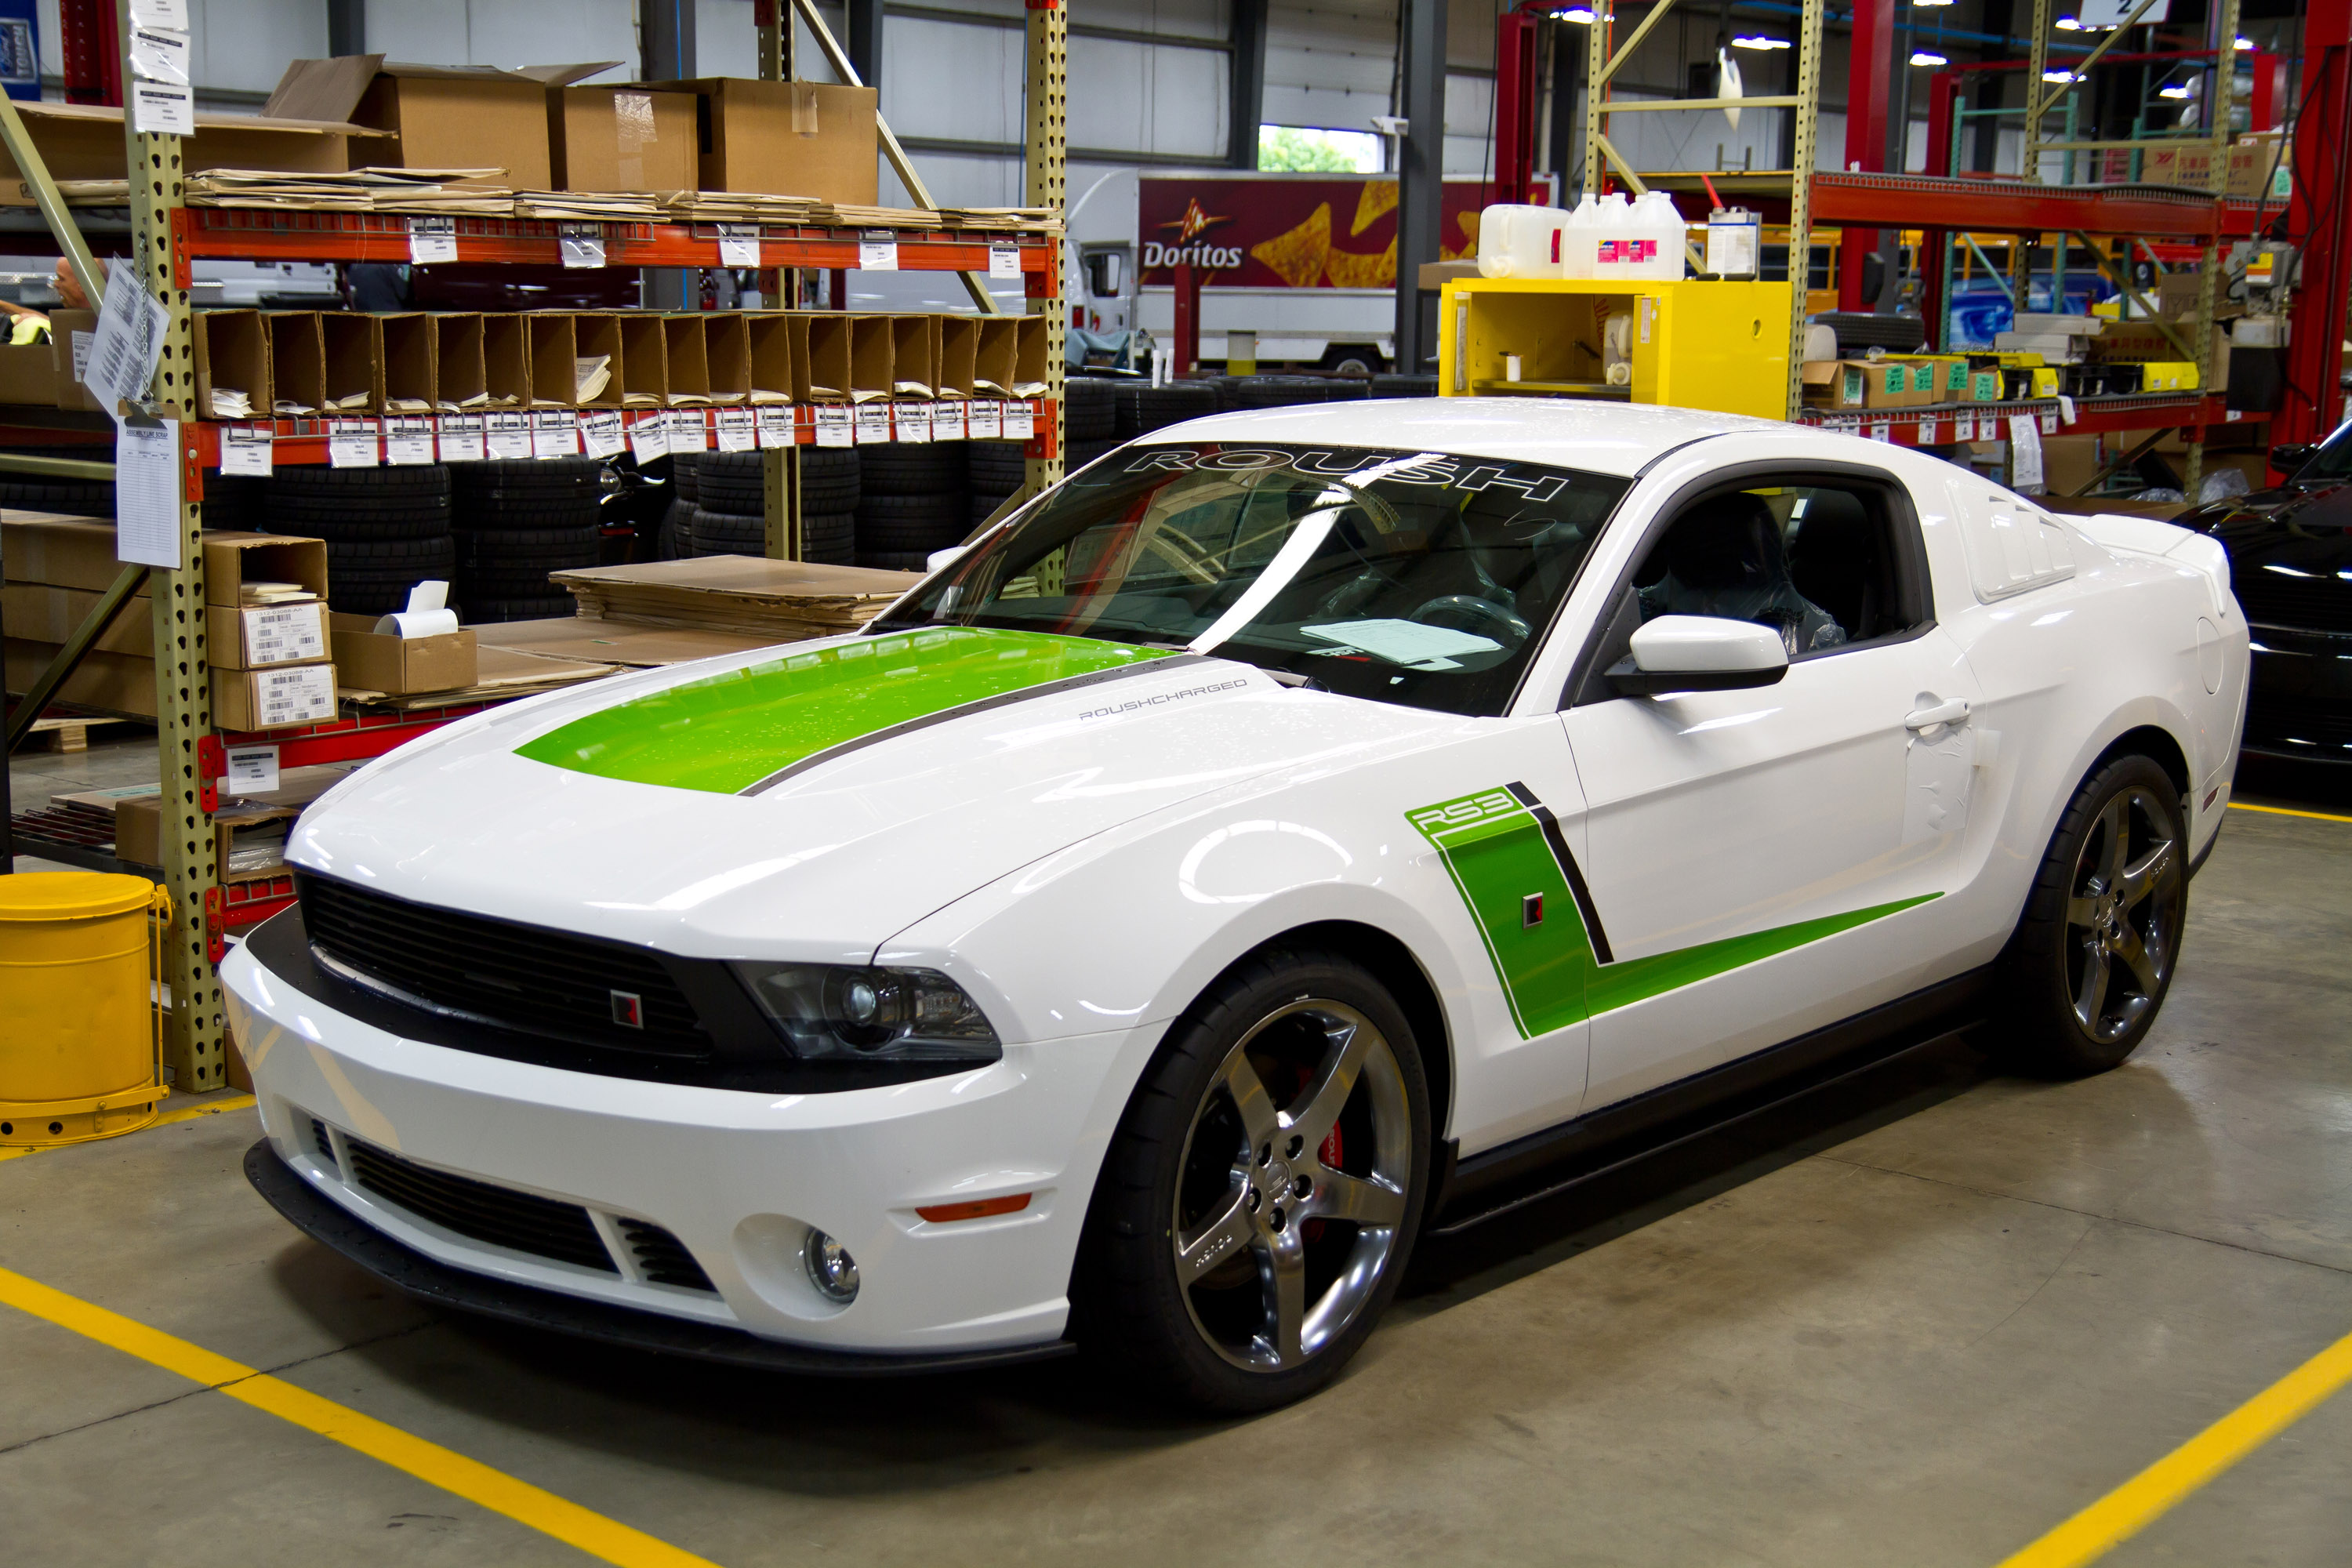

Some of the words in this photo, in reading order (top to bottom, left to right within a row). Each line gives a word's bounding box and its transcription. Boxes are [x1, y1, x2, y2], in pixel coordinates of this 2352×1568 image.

[1143, 239, 1243, 268] Doritos
[1124, 449, 1570, 503] ROUSH
[1078, 678, 1248, 721] ROUSHCHARGED
[1412, 792, 1515, 831] RS3
